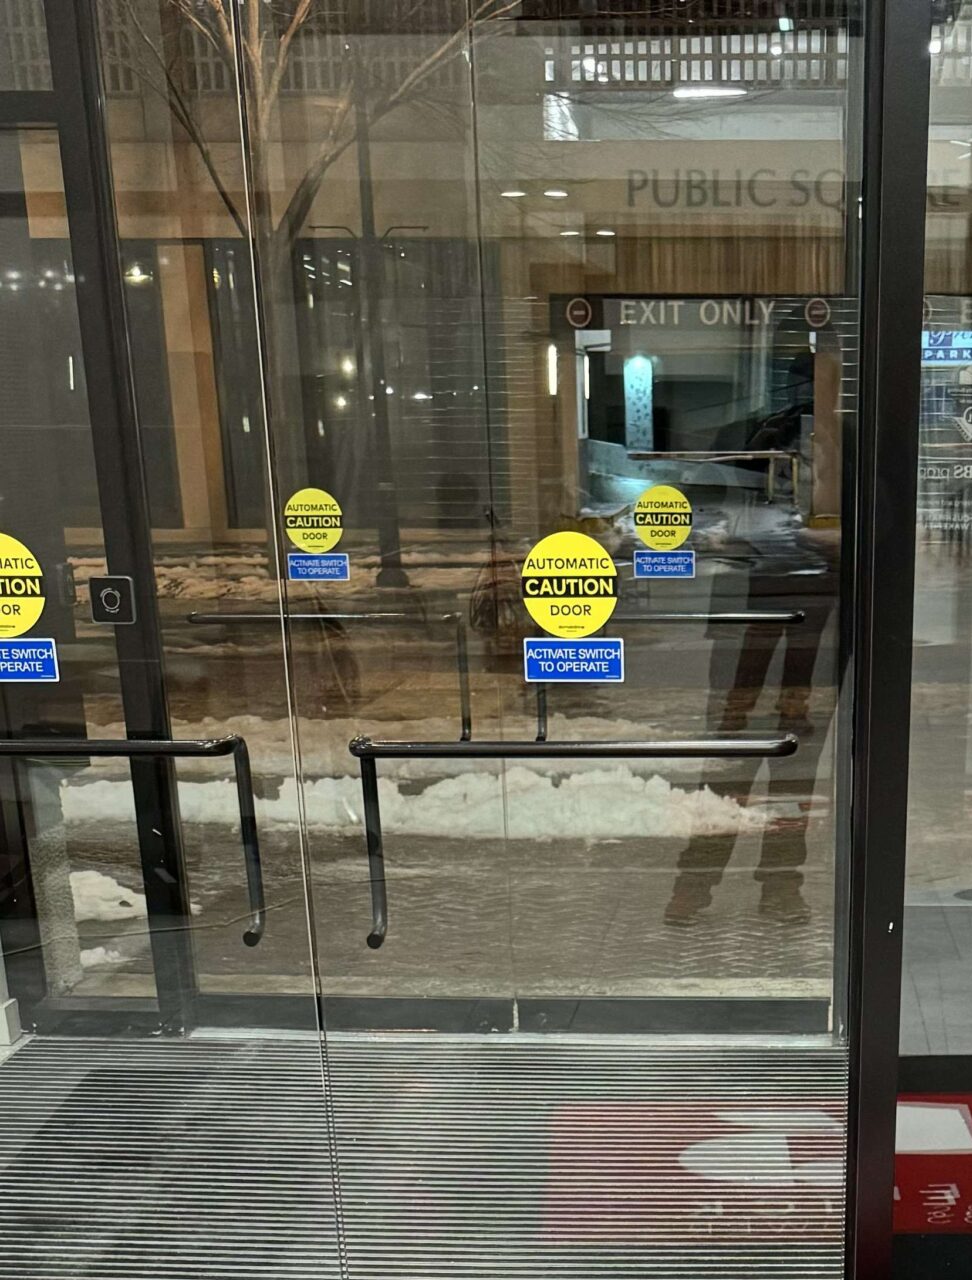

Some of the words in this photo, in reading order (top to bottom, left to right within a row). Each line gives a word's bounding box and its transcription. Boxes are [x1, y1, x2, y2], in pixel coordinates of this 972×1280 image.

[627, 168, 777, 208] PUBLIC
[620, 300, 685, 326] EXIT
[700, 300, 776, 326] ONLY
[287, 504, 338, 512] AUTOMATIC
[637, 501, 688, 509] AUTOMATIC
[286, 517, 341, 528] CAUTION
[636, 513, 690, 525] CAUTION
[650, 530, 676, 538] DOOR
[526, 558, 610, 570] AUTOMATIC
[297, 567, 307, 575] TO
[308, 567, 341, 575] OPERATE
[525, 578, 613, 595] CAUTION
[550, 605, 592, 616] DOOR
[11, 648, 53, 660] SWITCH
[526, 648, 576, 660] ACTIVATE
[578, 648, 620, 660] SWITCH
[0, 661, 44, 673] PERATE
[538, 661, 554, 673] TO
[556, 661, 610, 673] OPERATE
